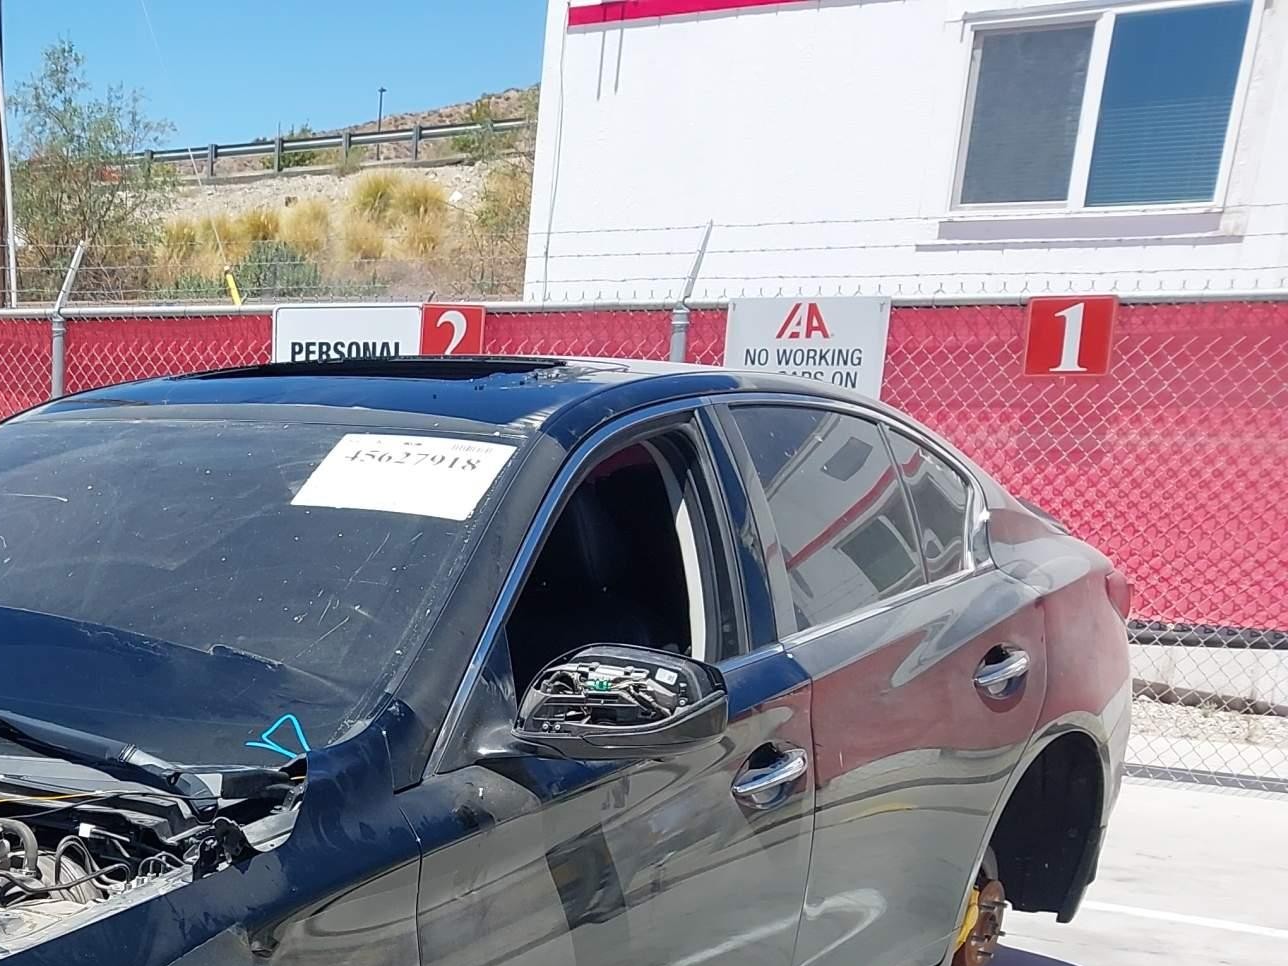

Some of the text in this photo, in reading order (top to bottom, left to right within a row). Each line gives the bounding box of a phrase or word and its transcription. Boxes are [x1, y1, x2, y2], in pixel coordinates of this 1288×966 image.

[436, 310, 467, 355] 2
[1049, 302, 1087, 371] 1
[744, 348, 862, 367] NO WORKING
